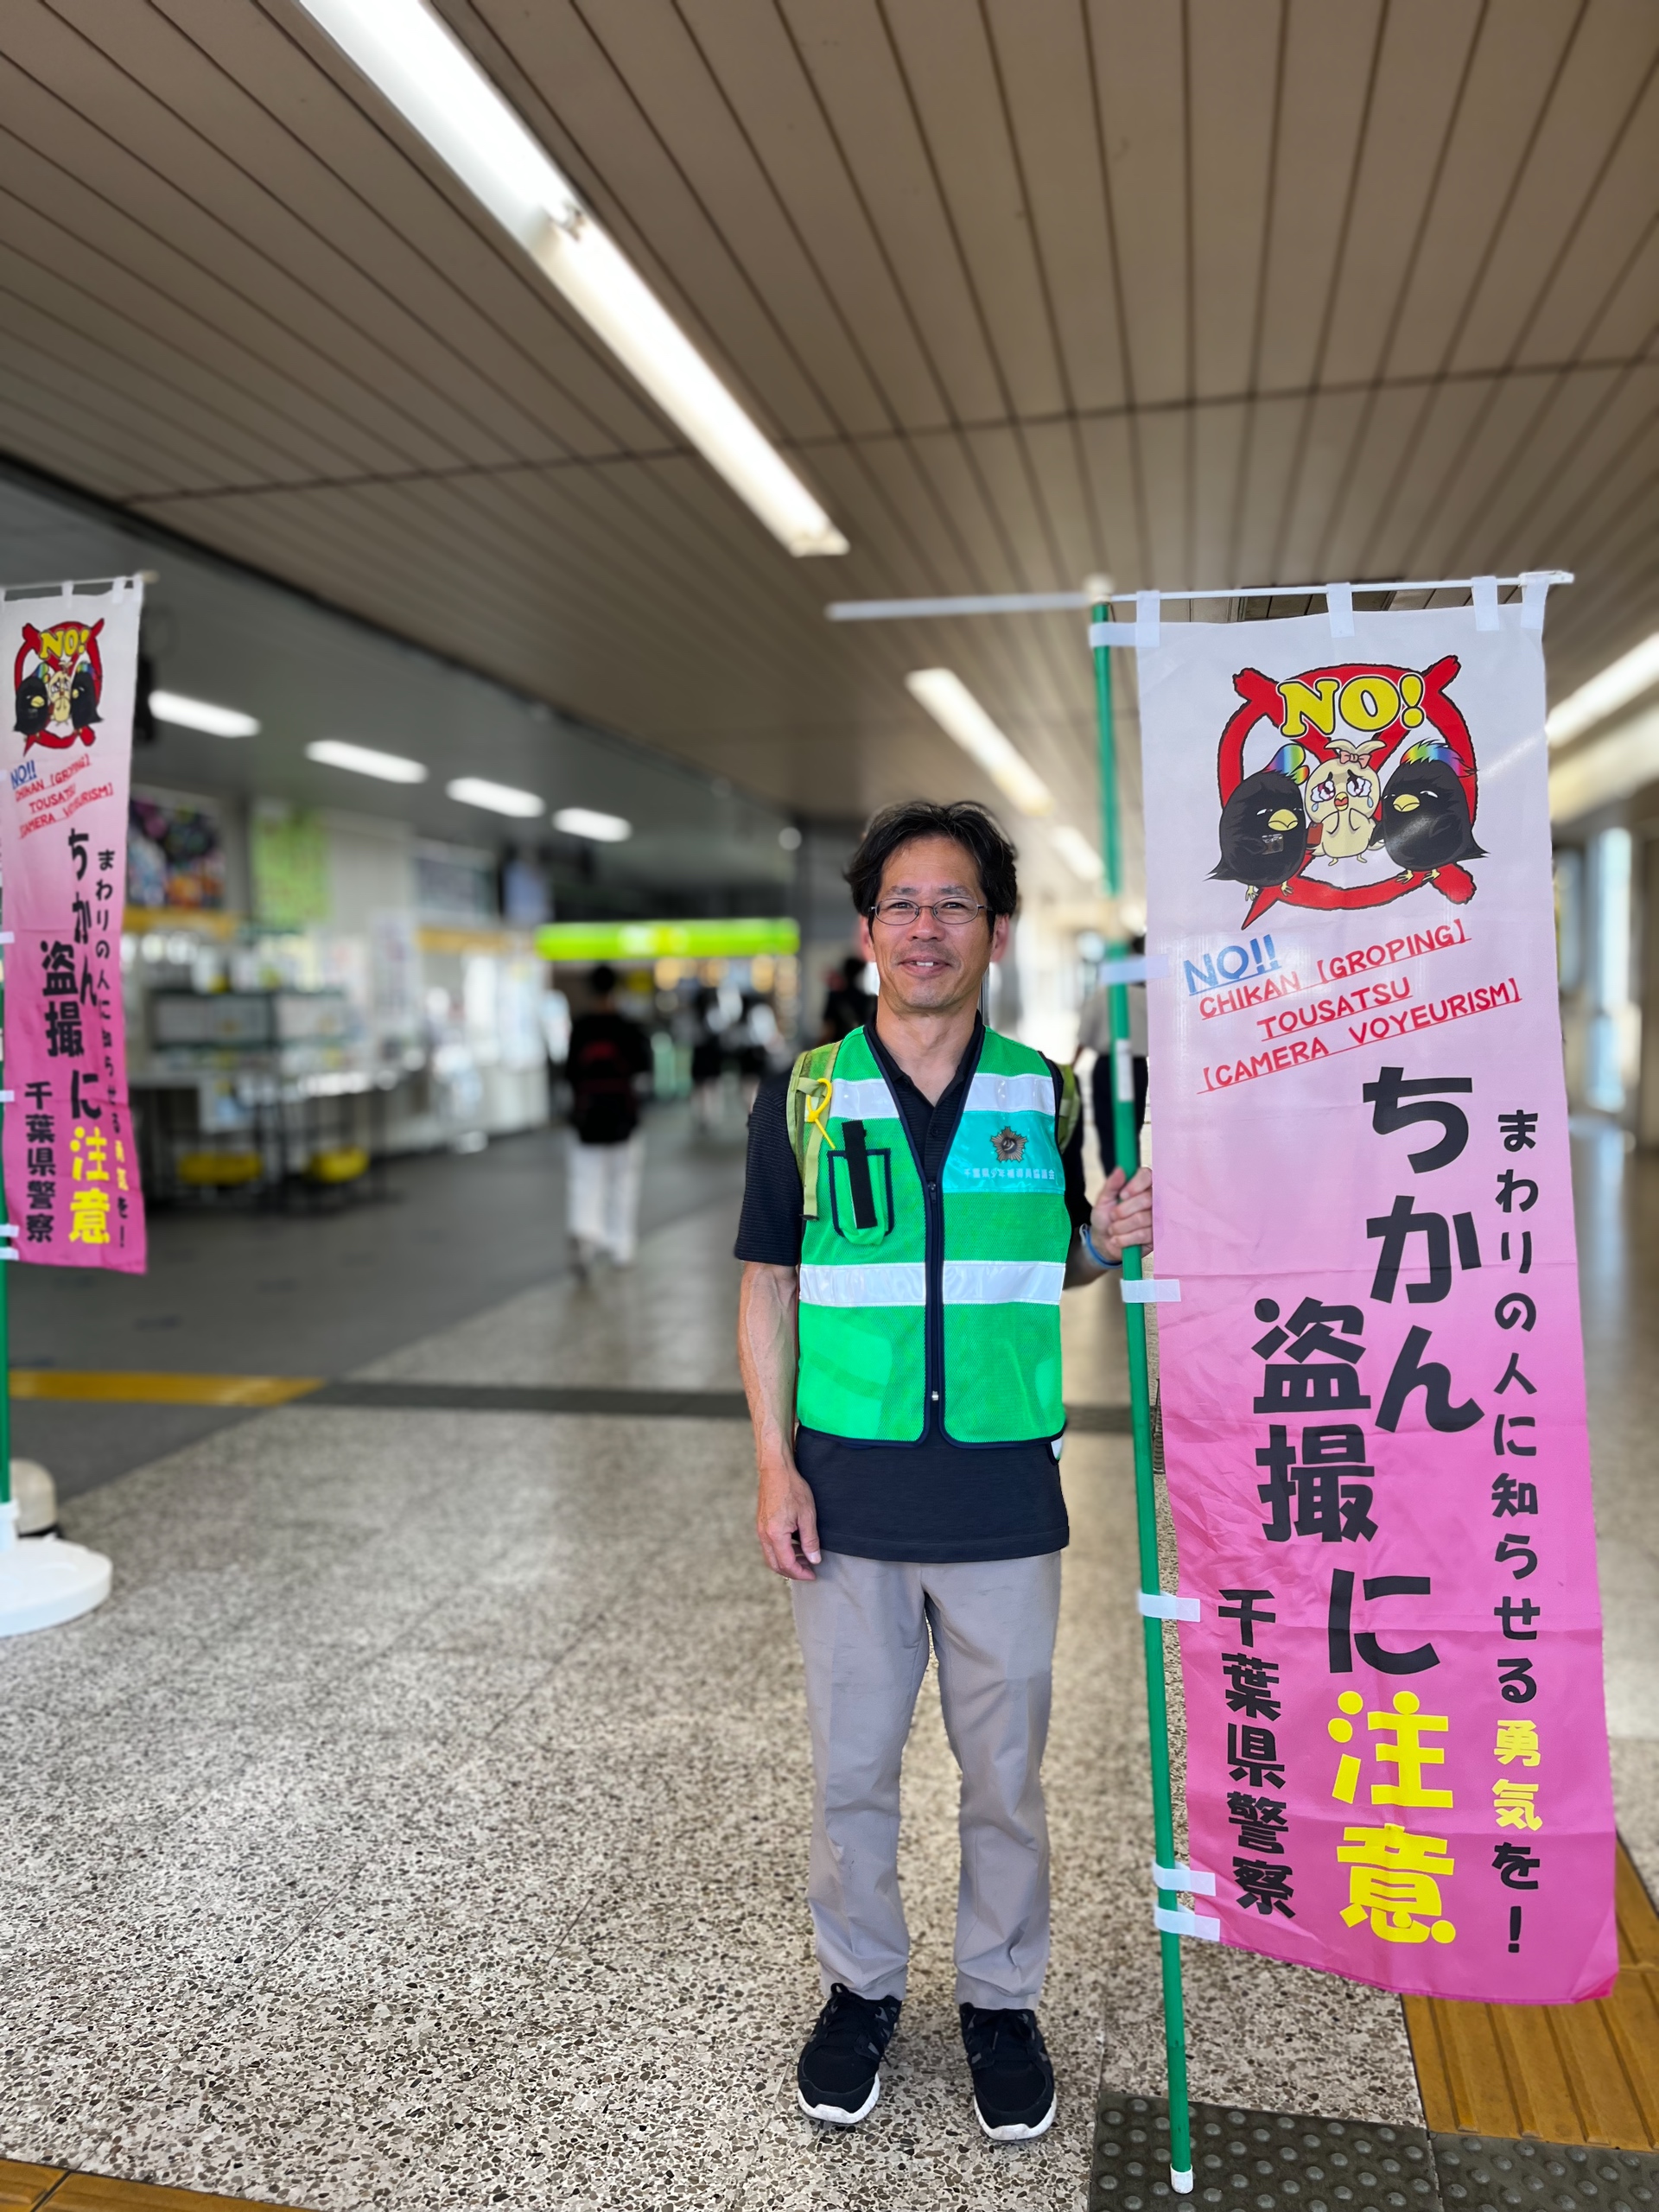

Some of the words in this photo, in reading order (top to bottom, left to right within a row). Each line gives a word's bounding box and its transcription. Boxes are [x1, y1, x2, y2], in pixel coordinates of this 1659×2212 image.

[39, 629, 89, 659] NO!
[1277, 674, 1425, 737] NO!
[10, 760, 37, 790] NO!!
[1184, 934, 1281, 995] NO!!
[1198, 971, 1301, 1020] CHIKAN
[1257, 976, 1412, 1041] TOUSATSU
[25, 1082, 56, 1243] 千葉県警察
[1363, 1065, 1484, 1433] ちかん
[1217, 1588, 1296, 1919] 千葉県警察
